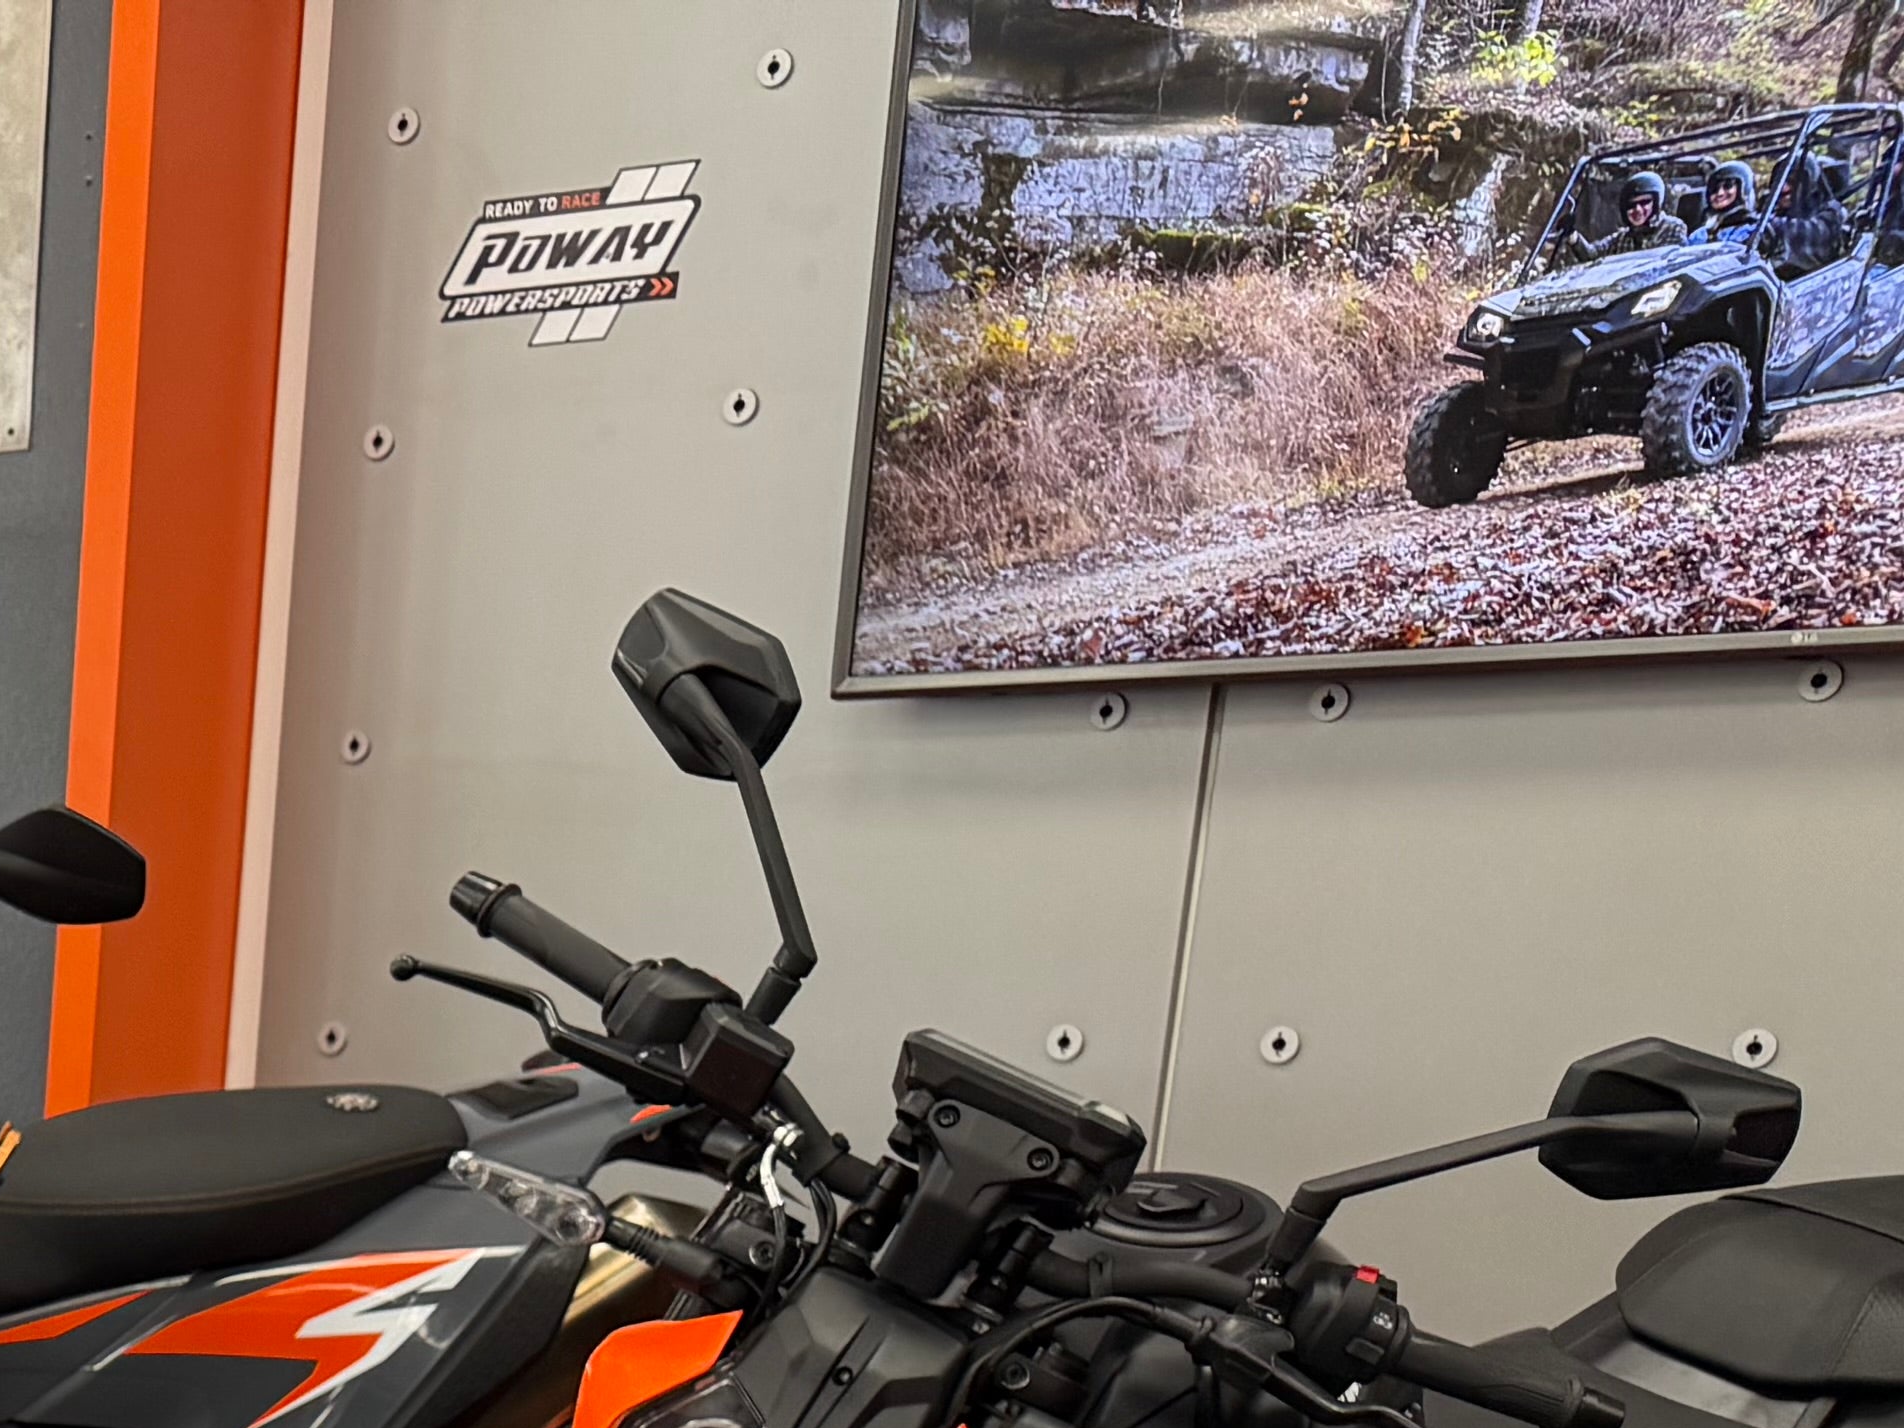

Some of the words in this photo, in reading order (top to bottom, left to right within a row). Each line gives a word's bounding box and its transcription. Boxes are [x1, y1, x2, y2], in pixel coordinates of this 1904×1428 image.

[485, 200, 534, 220] READY
[539, 196, 558, 212] TO
[561, 191, 602, 210] RACE
[447, 277, 646, 319] POWERSPORTS
